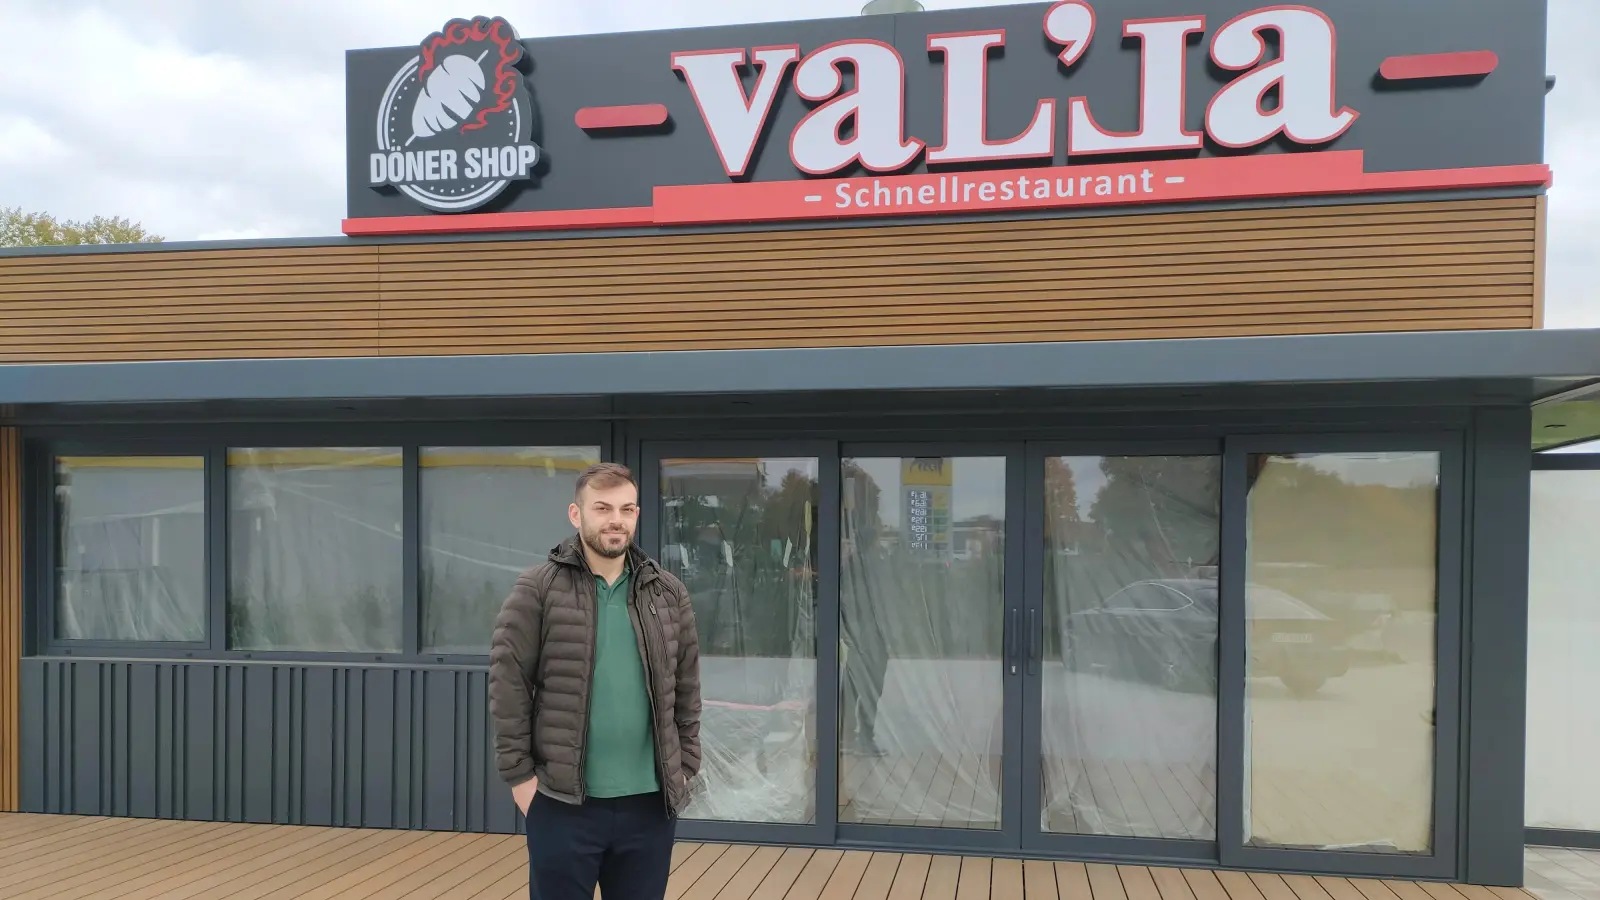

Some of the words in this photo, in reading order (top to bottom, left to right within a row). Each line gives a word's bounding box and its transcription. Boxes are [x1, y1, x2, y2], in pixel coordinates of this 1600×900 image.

[370, 146, 457, 183] DÖNER
[464, 145, 536, 178] SHOP
[835, 168, 1154, 208] Schnellrestaurant
